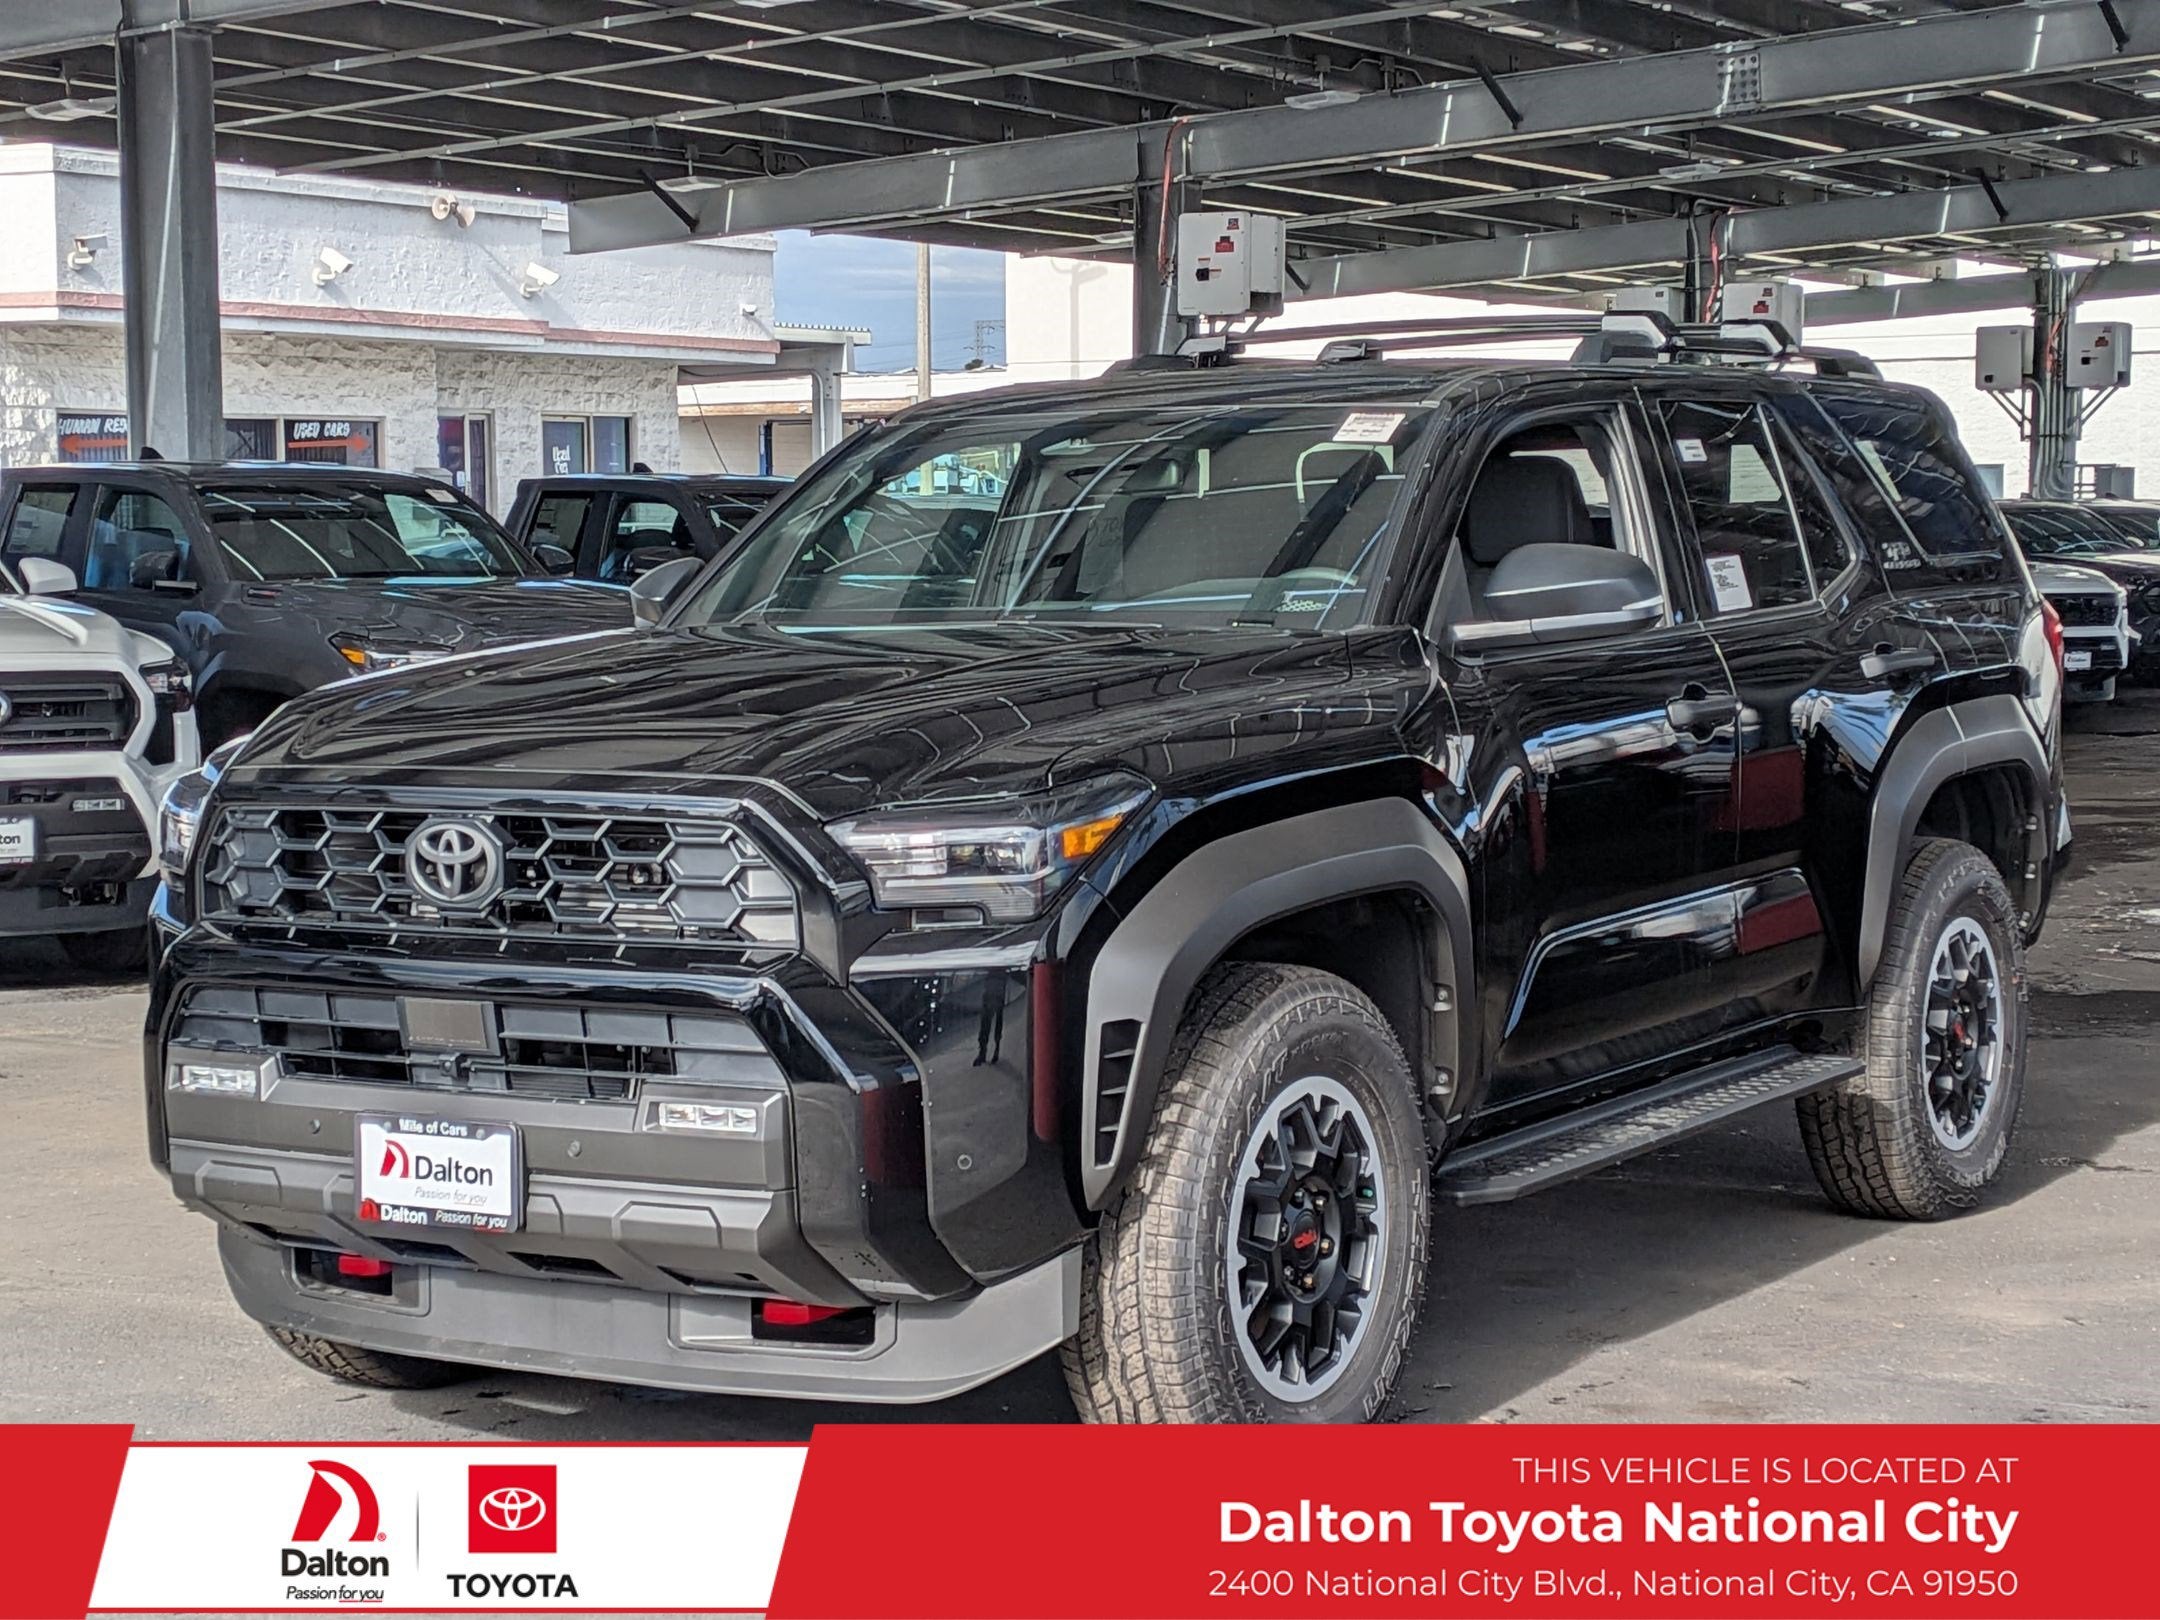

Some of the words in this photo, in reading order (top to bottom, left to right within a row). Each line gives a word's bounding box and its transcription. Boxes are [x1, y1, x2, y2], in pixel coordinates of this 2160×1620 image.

[58, 417, 101, 435] HUMAN
[293, 422, 321, 440] USED
[323, 421, 351, 437] CARS
[399, 1118, 424, 1133] Mile
[426, 1121, 439, 1134] of
[440, 1122, 468, 1137] Cars
[415, 1155, 493, 1186] Dalton
[415, 1186, 450, 1201] Passion
[453, 1189, 468, 1203] for
[469, 1192, 488, 1205] you
[381, 1205, 428, 1225] Dalton
[435, 1209, 471, 1225] Passion
[473, 1213, 488, 1227] for
[488, 1215, 508, 1229] you
